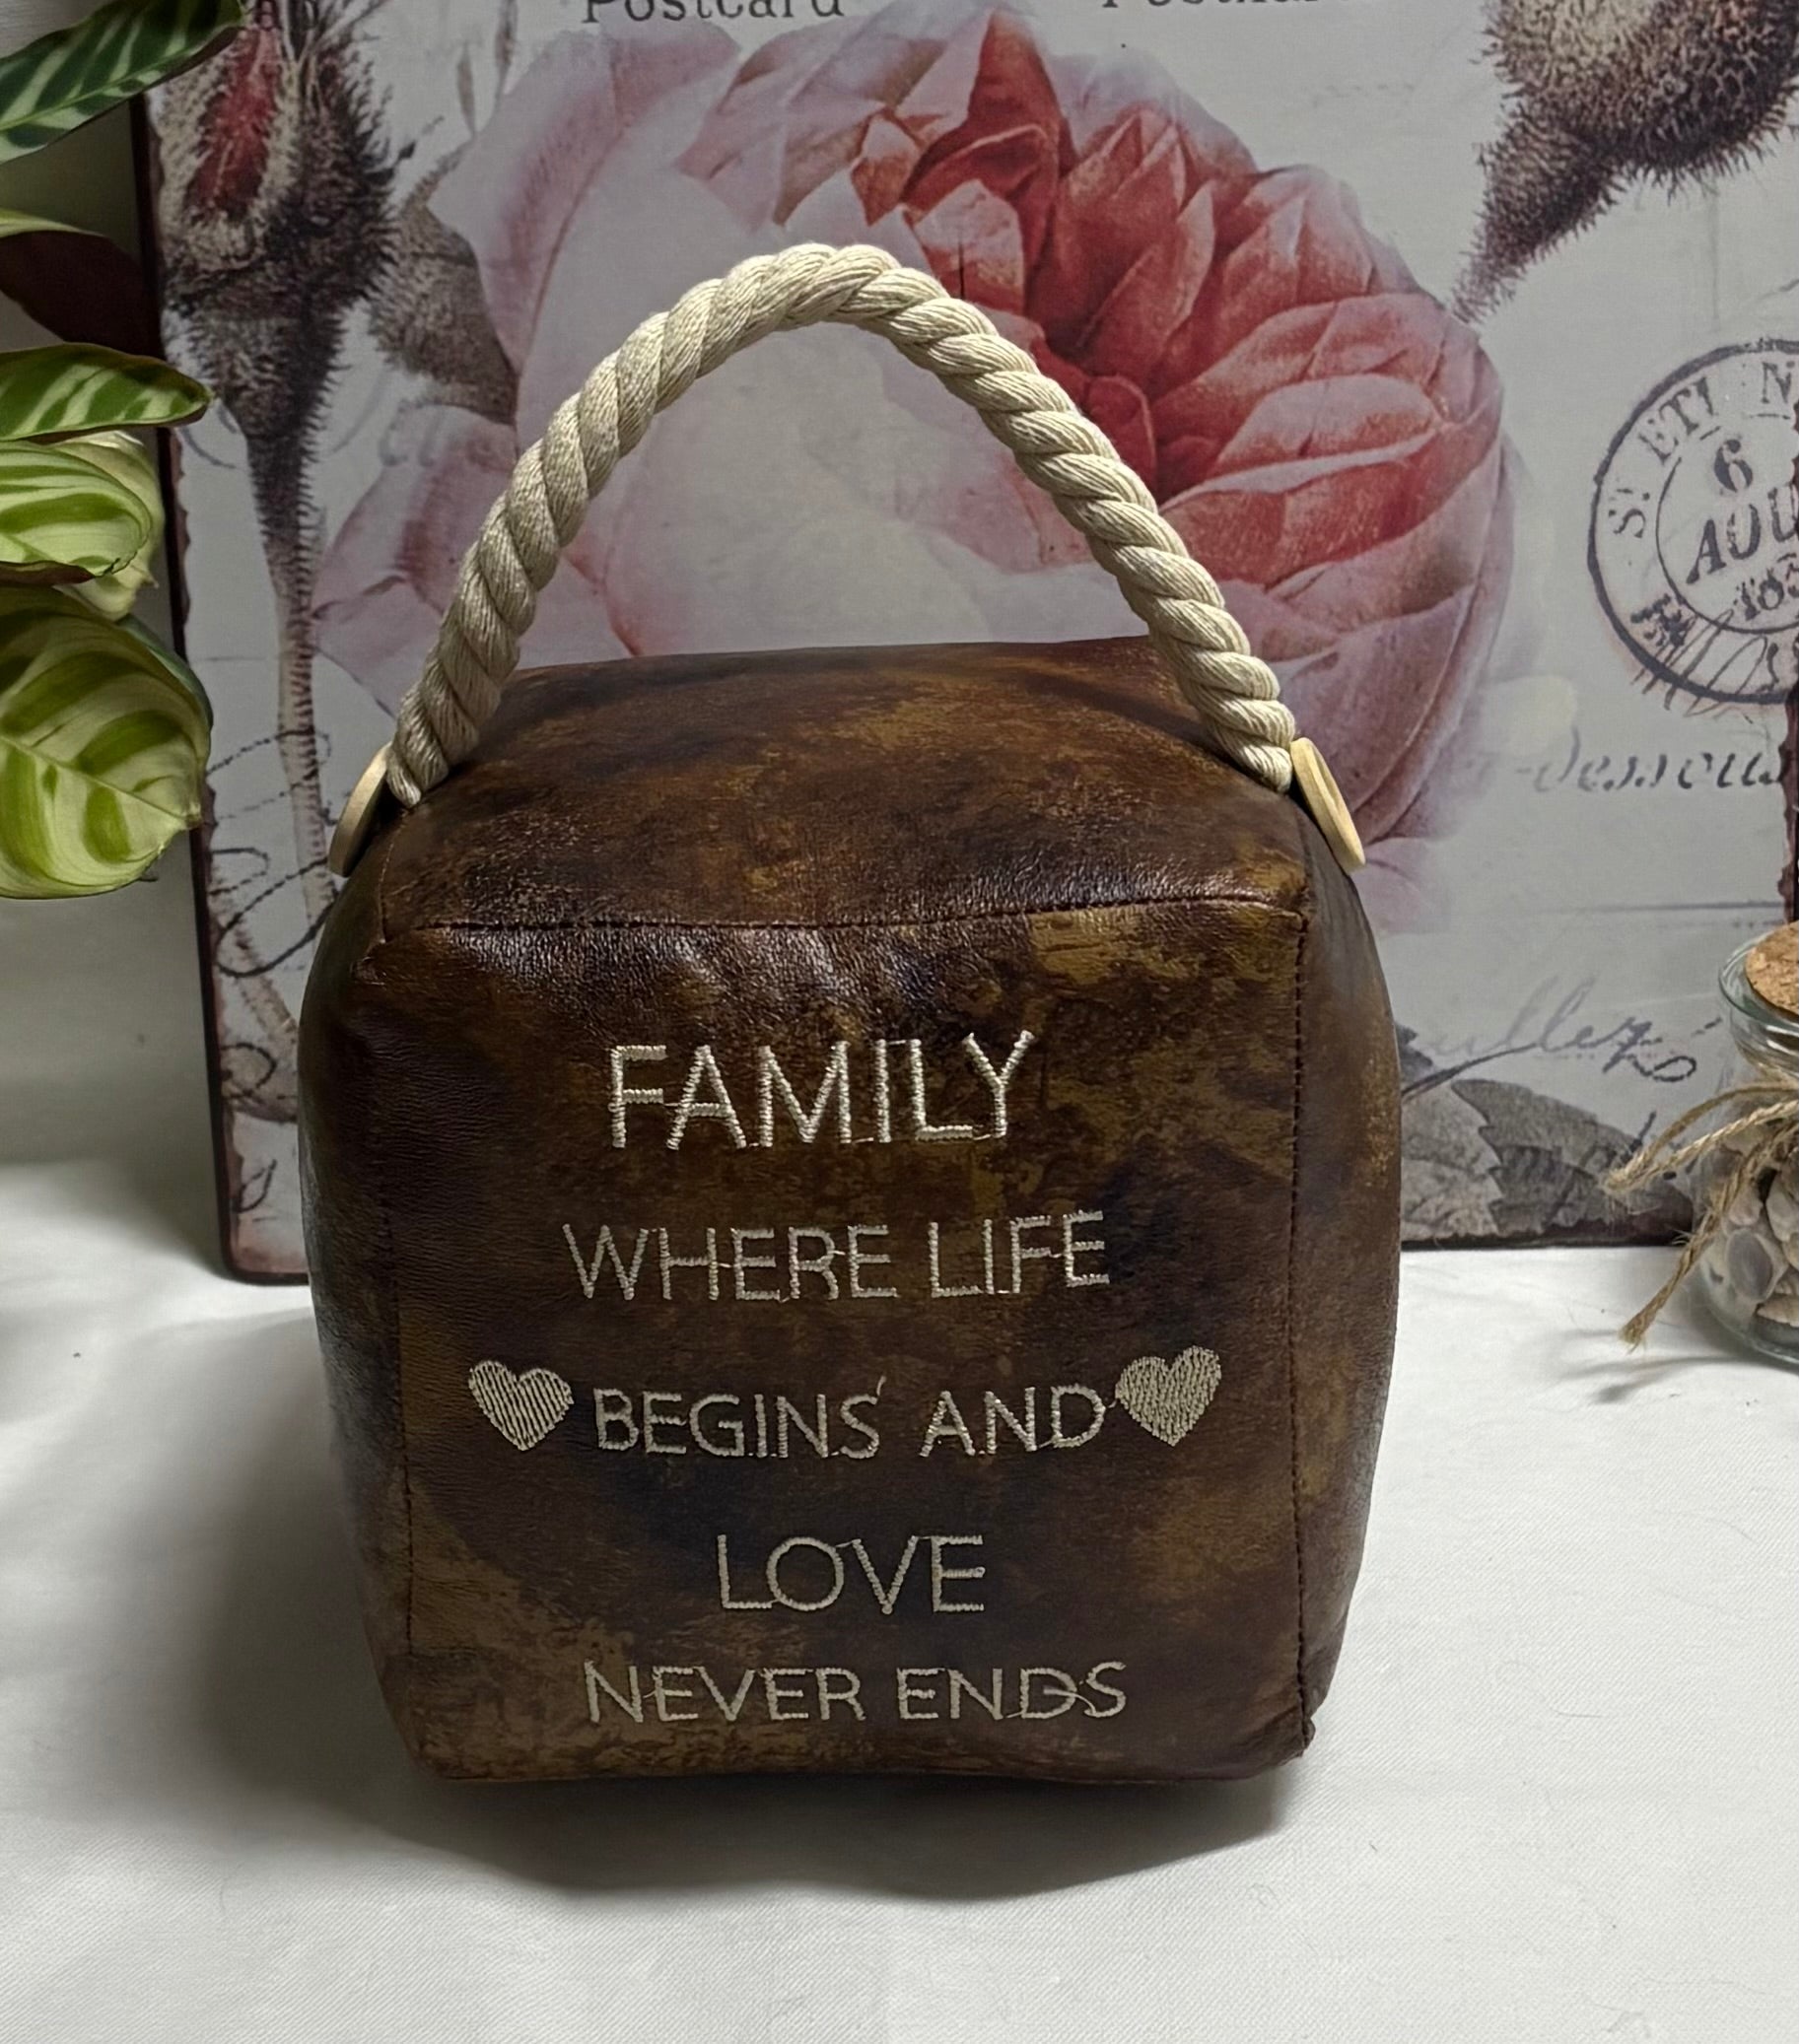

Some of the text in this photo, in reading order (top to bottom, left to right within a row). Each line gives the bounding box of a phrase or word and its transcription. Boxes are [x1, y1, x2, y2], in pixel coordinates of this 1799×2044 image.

[1713, 439, 1754, 493] 6
[607, 1029, 1037, 1151] FAMILY
[560, 1209, 1111, 1304] WHERE LIFE
[592, 1384, 1108, 1460] BEGINS AND
[717, 1533, 986, 1616] LOVE
[583, 1661, 1128, 1725] NEVER ENDS
